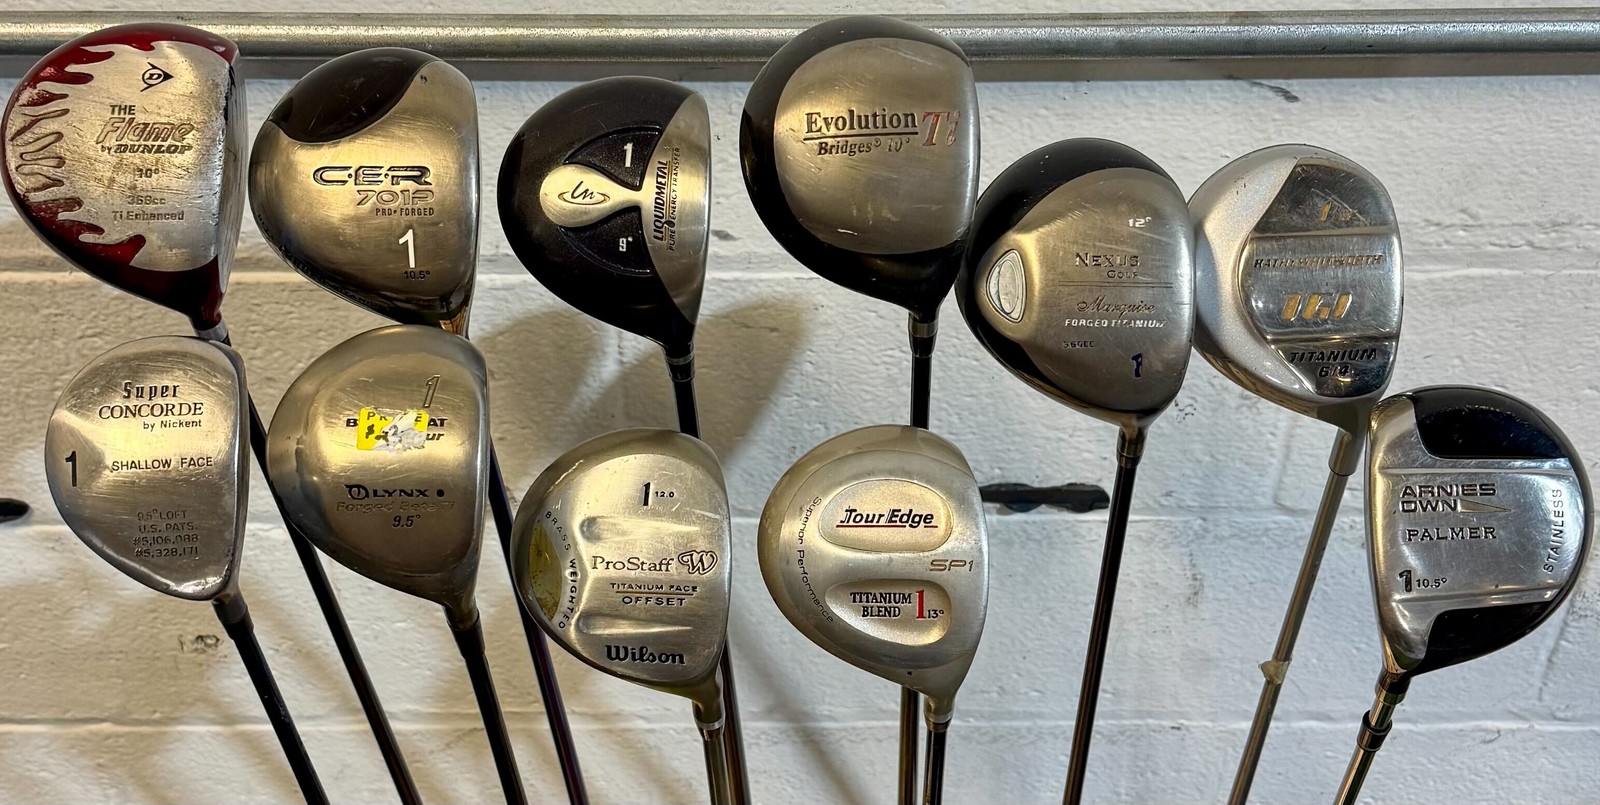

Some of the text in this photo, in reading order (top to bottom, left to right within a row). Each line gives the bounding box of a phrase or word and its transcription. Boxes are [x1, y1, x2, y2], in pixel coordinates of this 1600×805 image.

[110, 105, 136, 115] THE
[96, 117, 194, 144] Flame
[805, 108, 961, 147] Evolution Ti
[101, 144, 193, 154] by DUNLOP
[624, 142, 633, 167] 1
[672, 148, 681, 186] TRANSFER
[653, 160, 668, 241] LIQUIDMETAL
[670, 188, 678, 220] ENERGY
[112, 210, 184, 220] Ti Enhanced
[400, 208, 435, 216] FORGED
[1128, 217, 1152, 228] 12°
[399, 228, 415, 268] 1
[404, 271, 430, 279] 10.5°
[1076, 295, 1156, 318] Marquise
[1065, 319, 1108, 327] FORGED
[1290, 348, 1377, 363] TITANIUM
[1131, 353, 1143, 378] 1
[123, 382, 180, 401] Super
[423, 374, 440, 408] 1
[99, 402, 204, 419] CONCORDE
[143, 419, 202, 432] by Nickent
[65, 450, 78, 487] 1
[112, 456, 213, 471] SHALLOW FACE
[373, 489, 429, 497] LYNX
[643, 482, 651, 506] 1
[1401, 483, 1496, 498] ARNIES
[336, 501, 394, 514] Forged
[1401, 499, 1458, 513] OWN
[160, 510, 187, 520] LOFT
[392, 514, 421, 528] 9.5°
[138, 522, 199, 533] U.S. PATS.
[1406, 527, 1497, 541] PALMER
[1543, 488, 1564, 573] STAINLESS
[797, 496, 834, 623] Superior Performance
[545, 511, 577, 629] BRASS WEIGHTED
[1399, 570, 1448, 592] 1 10.5°
[622, 596, 686, 606] OFFSET
[850, 592, 912, 604] TITANIUM
[916, 589, 944, 619] 1 13°
[861, 605, 901, 618] BLEND
[605, 644, 685, 665] Wilson
